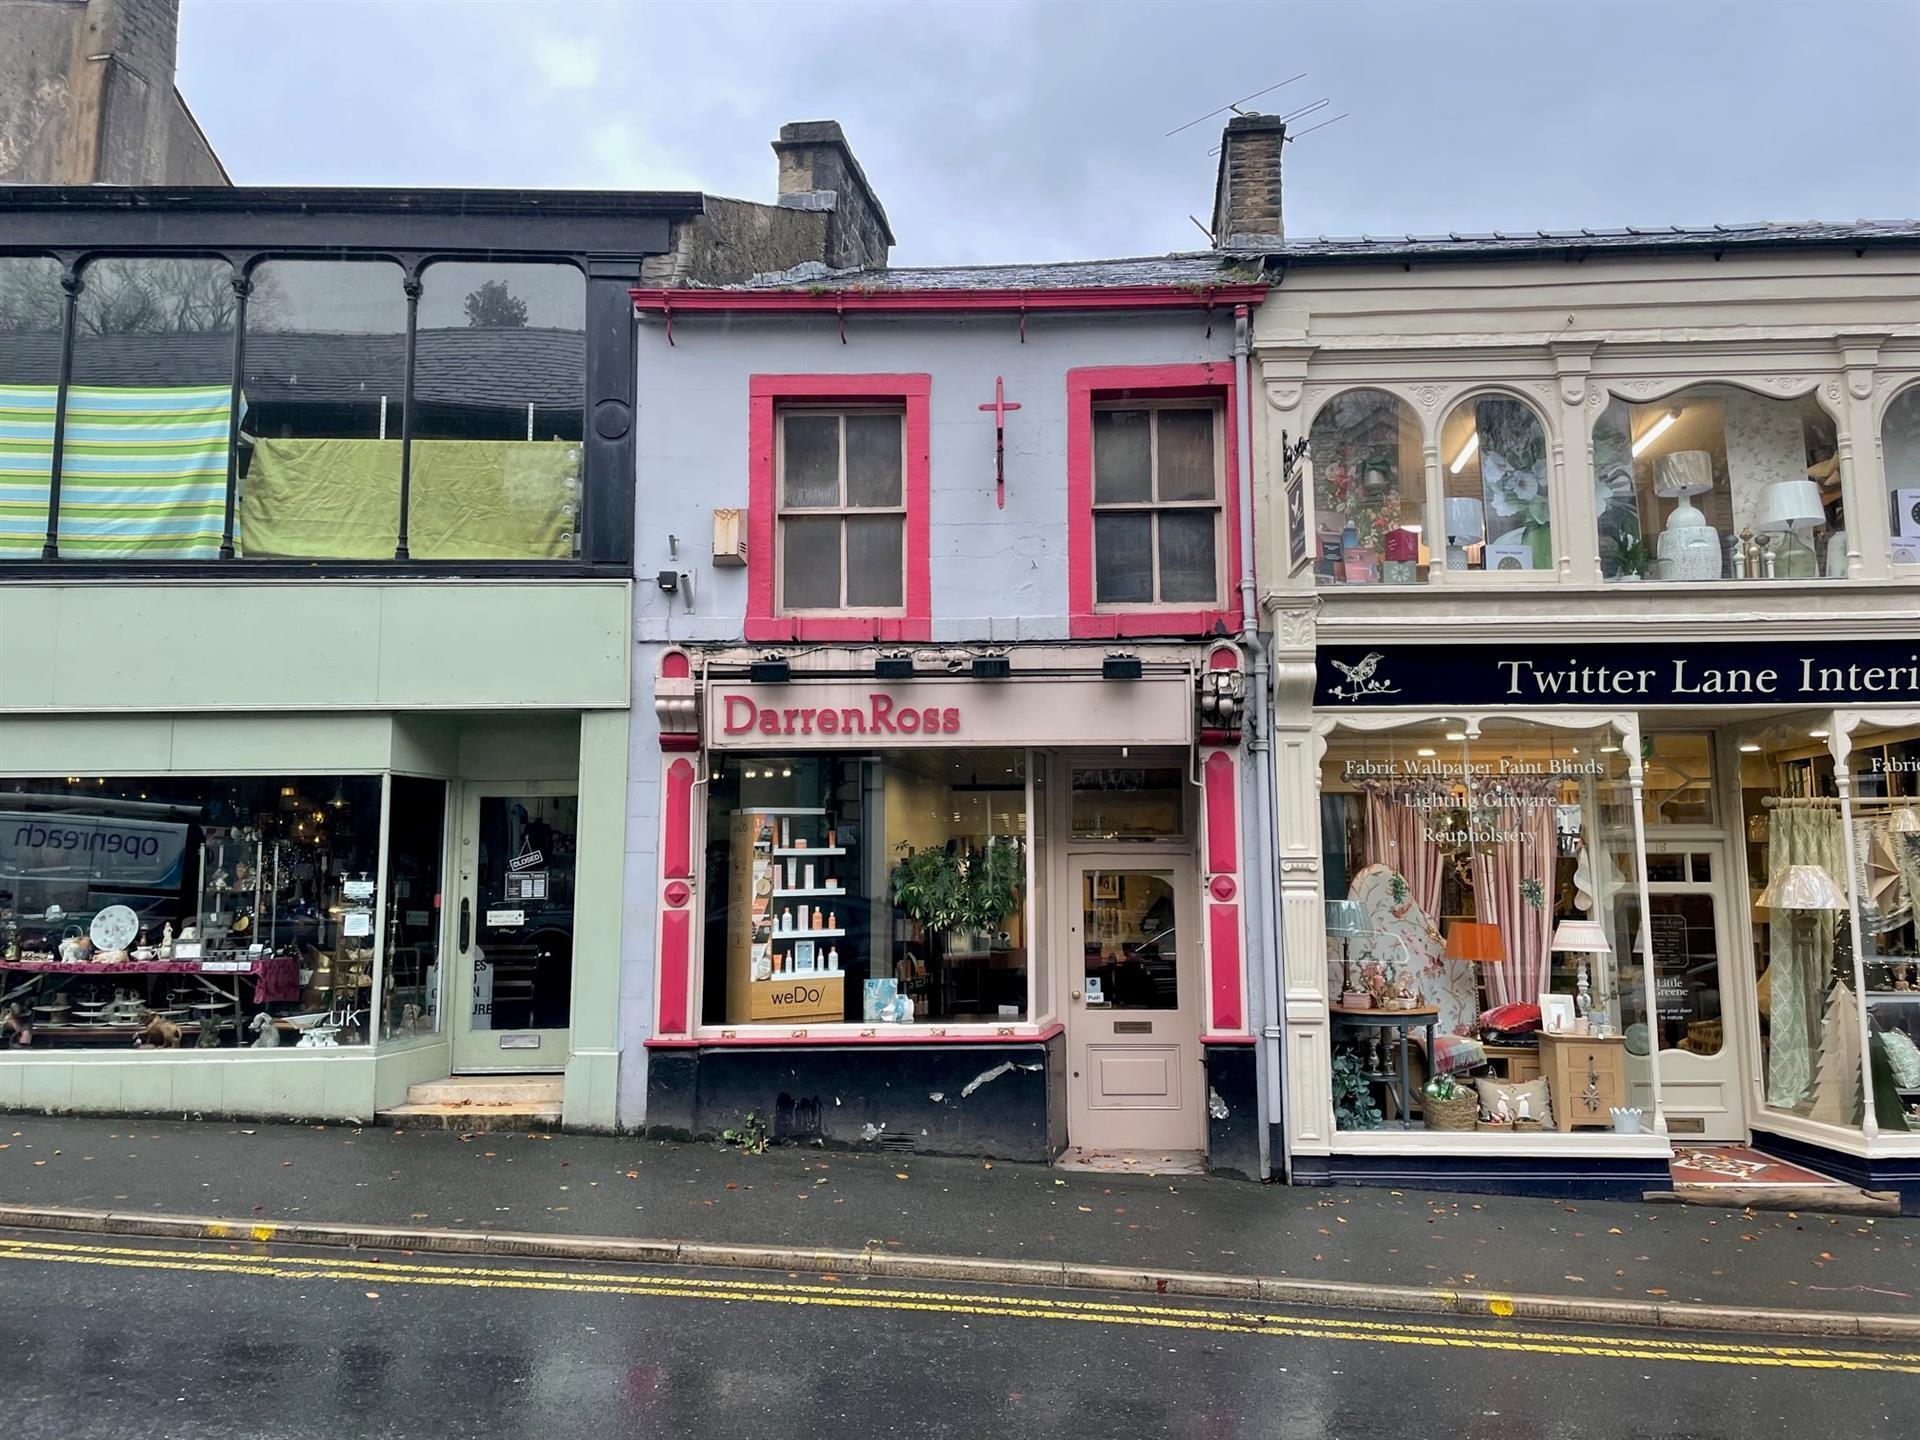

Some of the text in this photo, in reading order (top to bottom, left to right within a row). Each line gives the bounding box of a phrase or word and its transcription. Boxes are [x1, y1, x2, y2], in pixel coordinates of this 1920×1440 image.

[1497, 658, 1656, 695] Twitter
[1671, 658, 1778, 694] Lane
[723, 694, 960, 734] DarrenRoss
[1345, 759, 1604, 779] Fabric Wallpaper Paint Blinds
[1404, 792, 1558, 812] Lighting Giftware
[1422, 827, 1538, 847] Reupholstery
[512, 853, 541, 869] CLOSED
[1656, 978, 1683, 987] Little
